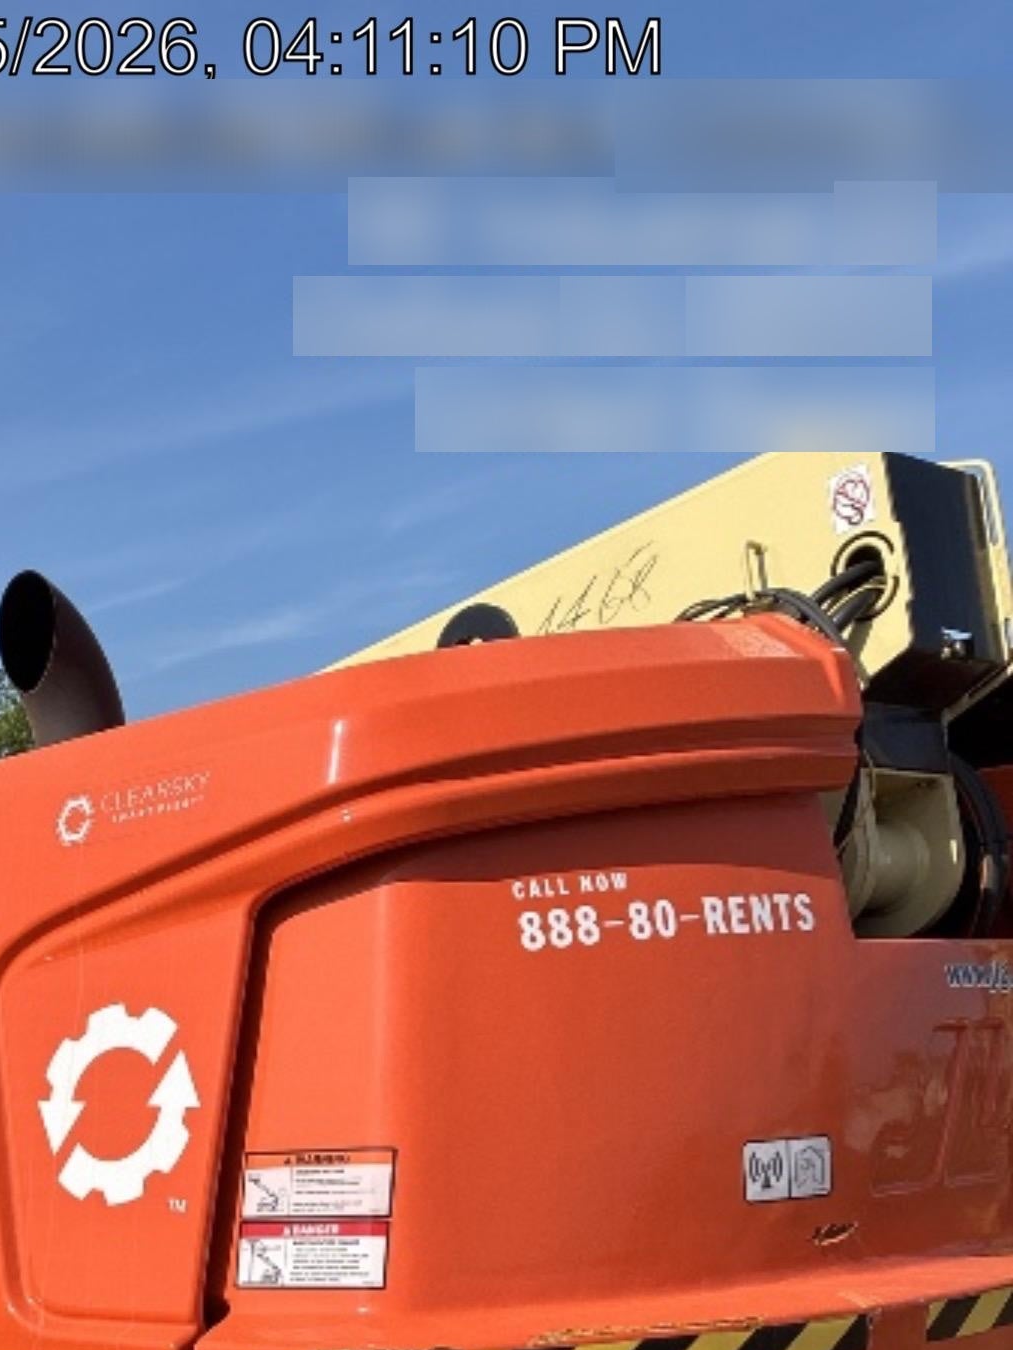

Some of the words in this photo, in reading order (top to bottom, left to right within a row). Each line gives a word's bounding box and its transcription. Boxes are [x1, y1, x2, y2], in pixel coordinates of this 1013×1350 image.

[511, 877, 570, 901] CALL
[580, 871, 629, 893] NOW
[518, 892, 816, 952] 888-80-RENTS
